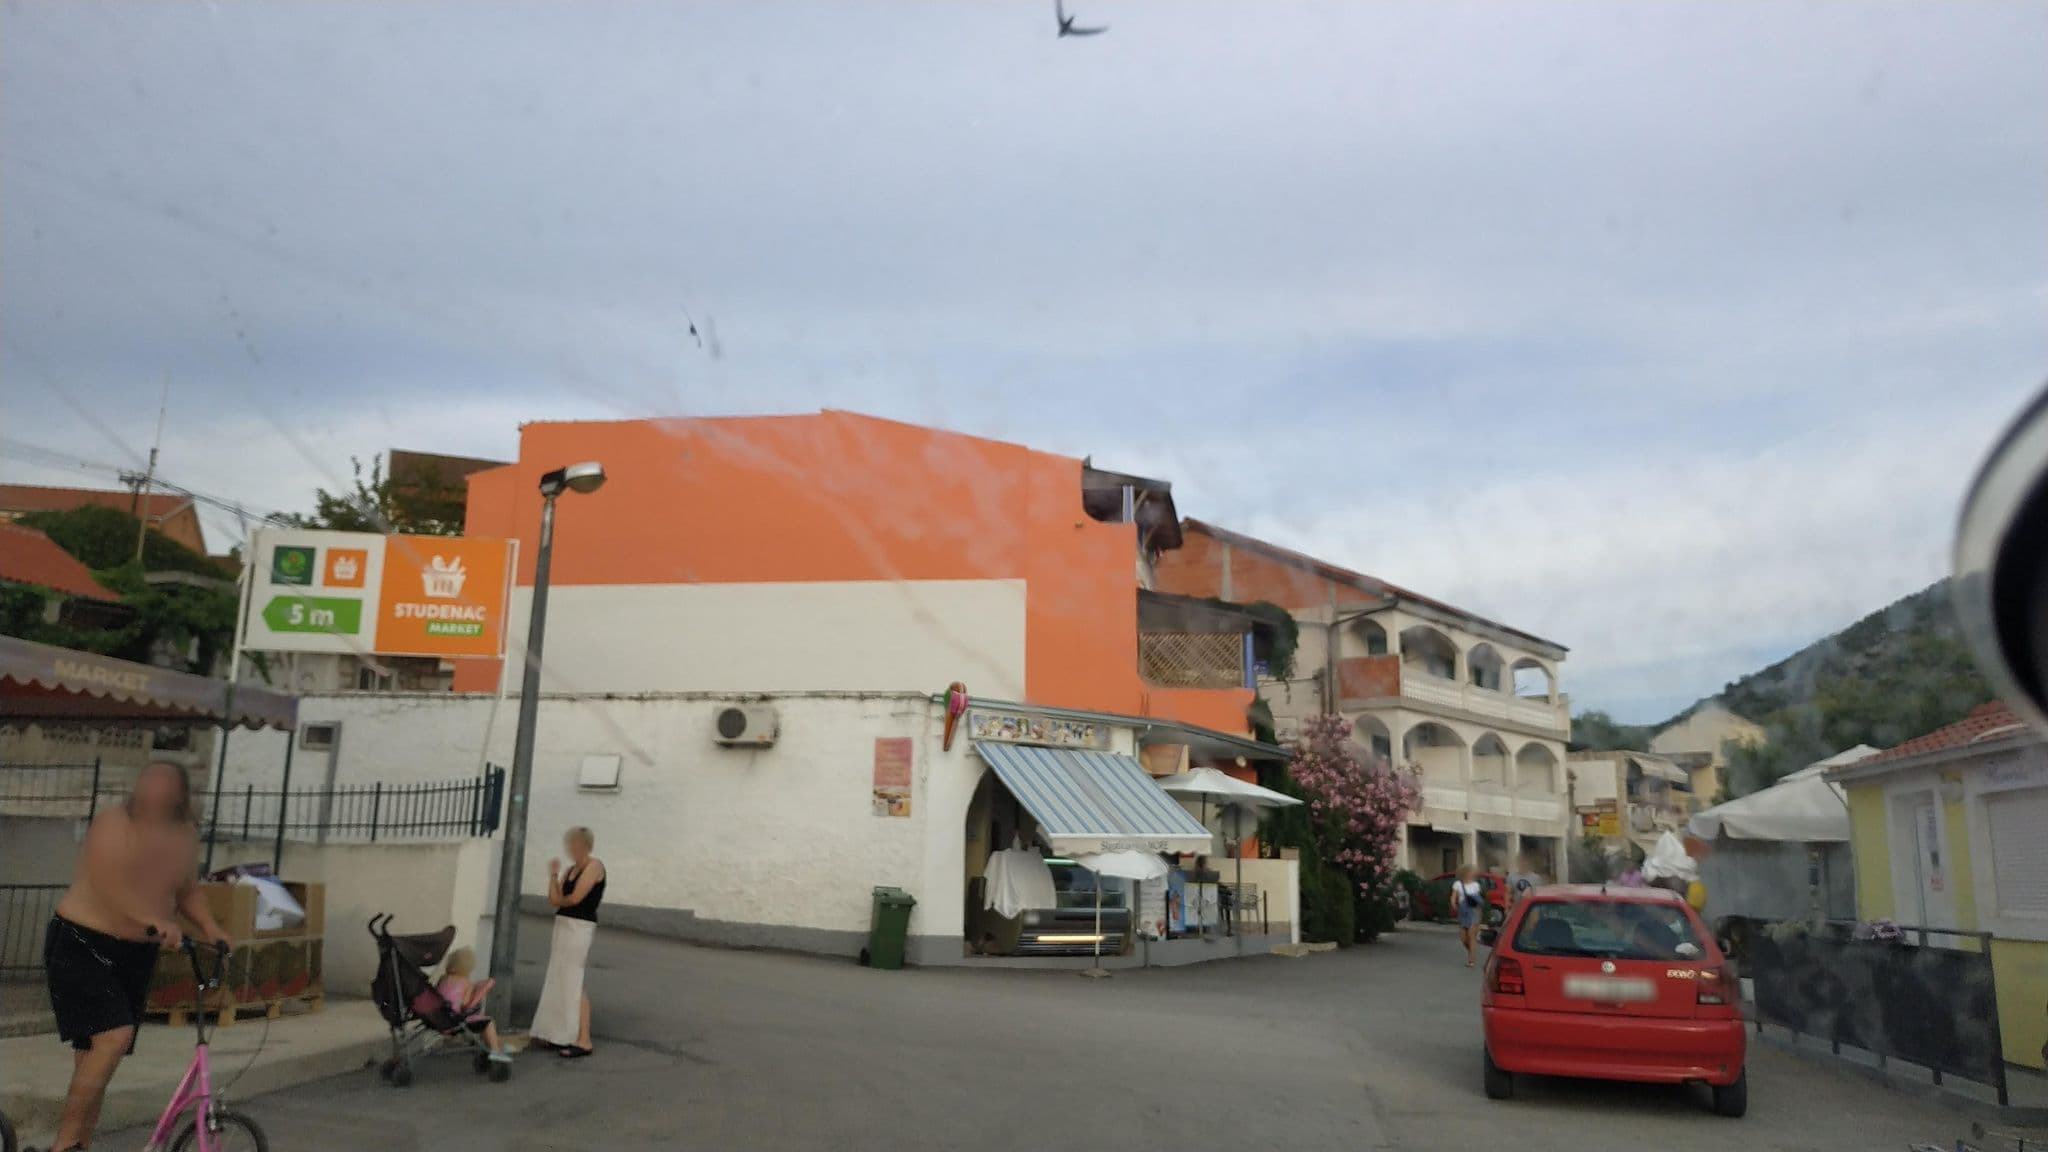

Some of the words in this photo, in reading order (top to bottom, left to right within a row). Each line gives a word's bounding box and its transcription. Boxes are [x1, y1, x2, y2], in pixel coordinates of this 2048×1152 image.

[288, 604, 305, 625] 5
[309, 607, 334, 626] m
[394, 603, 487, 621] STUDENAC
[428, 622, 481, 635] MARKET
[54, 658, 150, 691] MARKET
